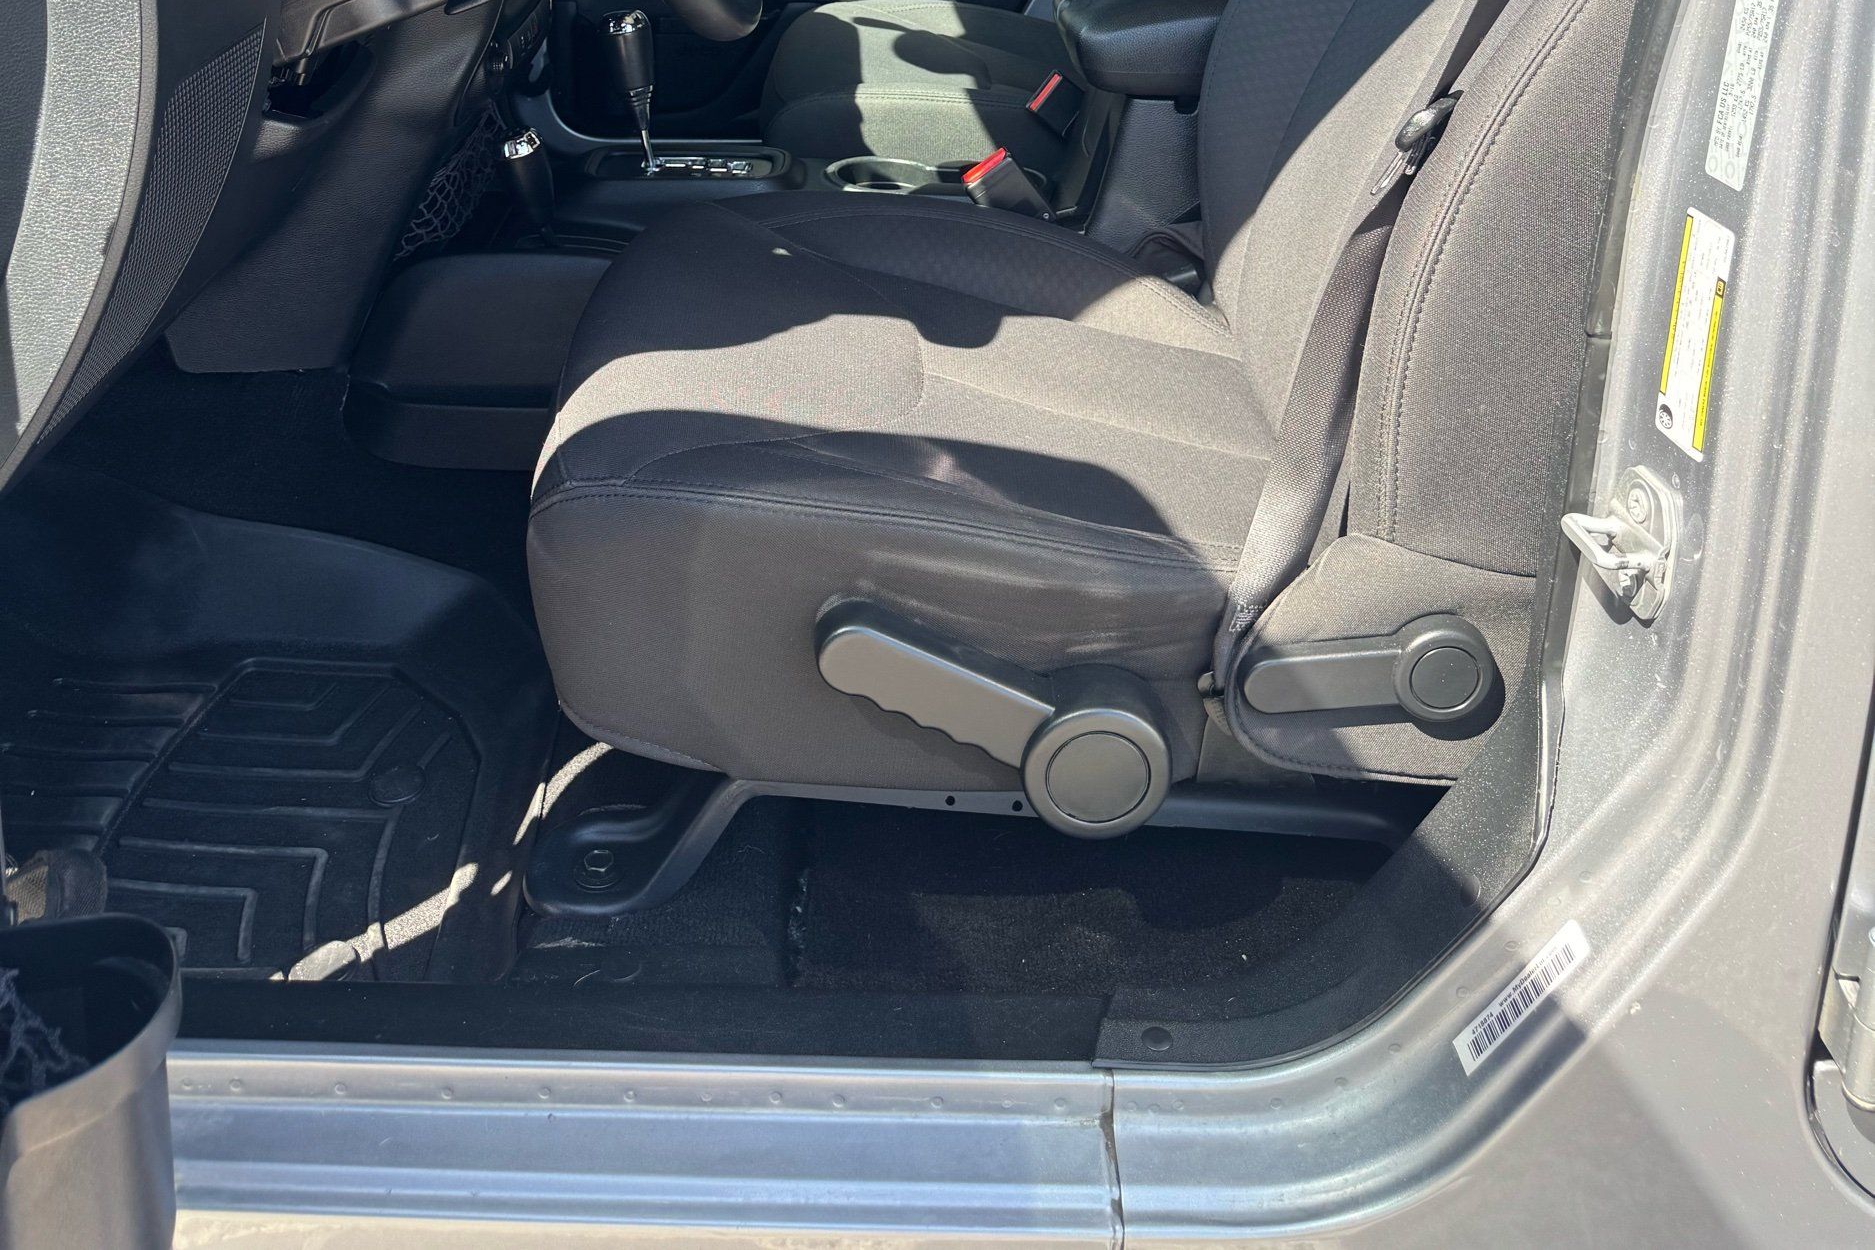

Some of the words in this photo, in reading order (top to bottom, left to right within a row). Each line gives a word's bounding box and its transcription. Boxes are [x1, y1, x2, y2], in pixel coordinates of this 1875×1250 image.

[1721, 80, 1729, 96] LLC
[1719, 96, 1726, 108] US
[1716, 108, 1724, 125] FCA
